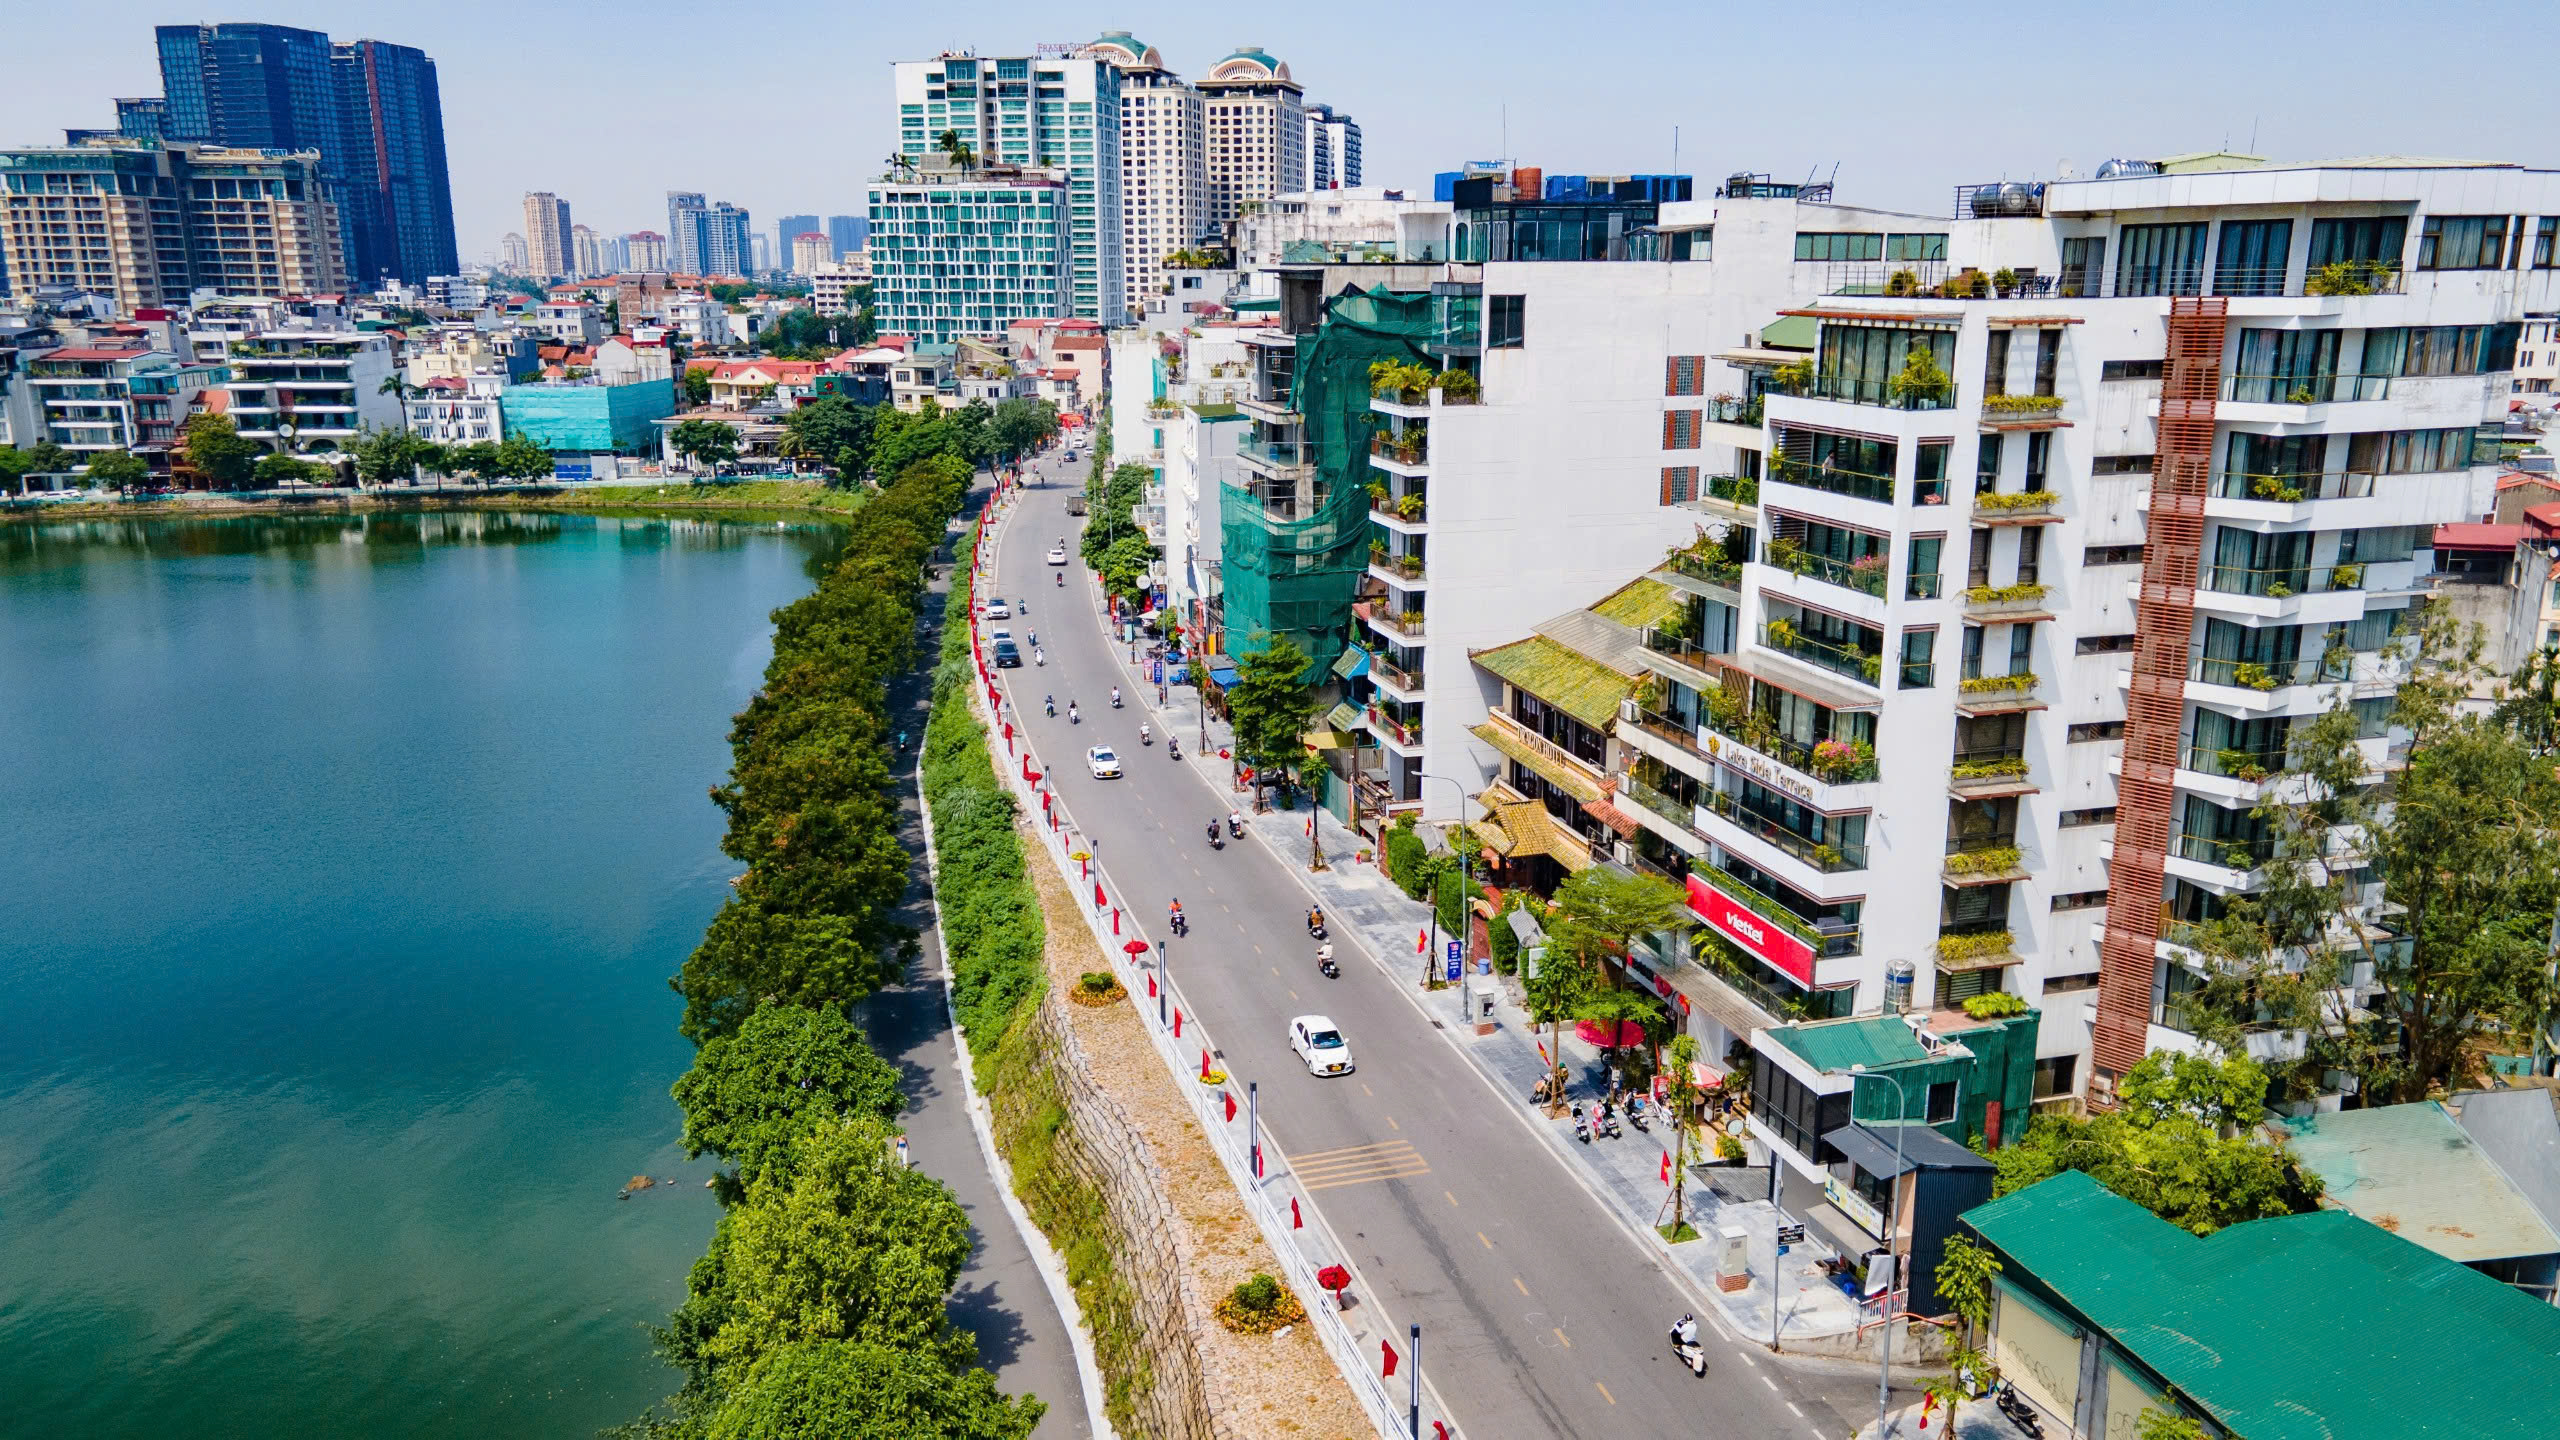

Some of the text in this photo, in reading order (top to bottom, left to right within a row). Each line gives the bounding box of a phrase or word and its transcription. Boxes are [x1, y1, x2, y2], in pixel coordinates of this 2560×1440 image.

[1543, 742, 1566, 768] HOTEL
[1724, 743, 1814, 801] Lake Side Terrace
[1725, 911, 1765, 946] viettel
